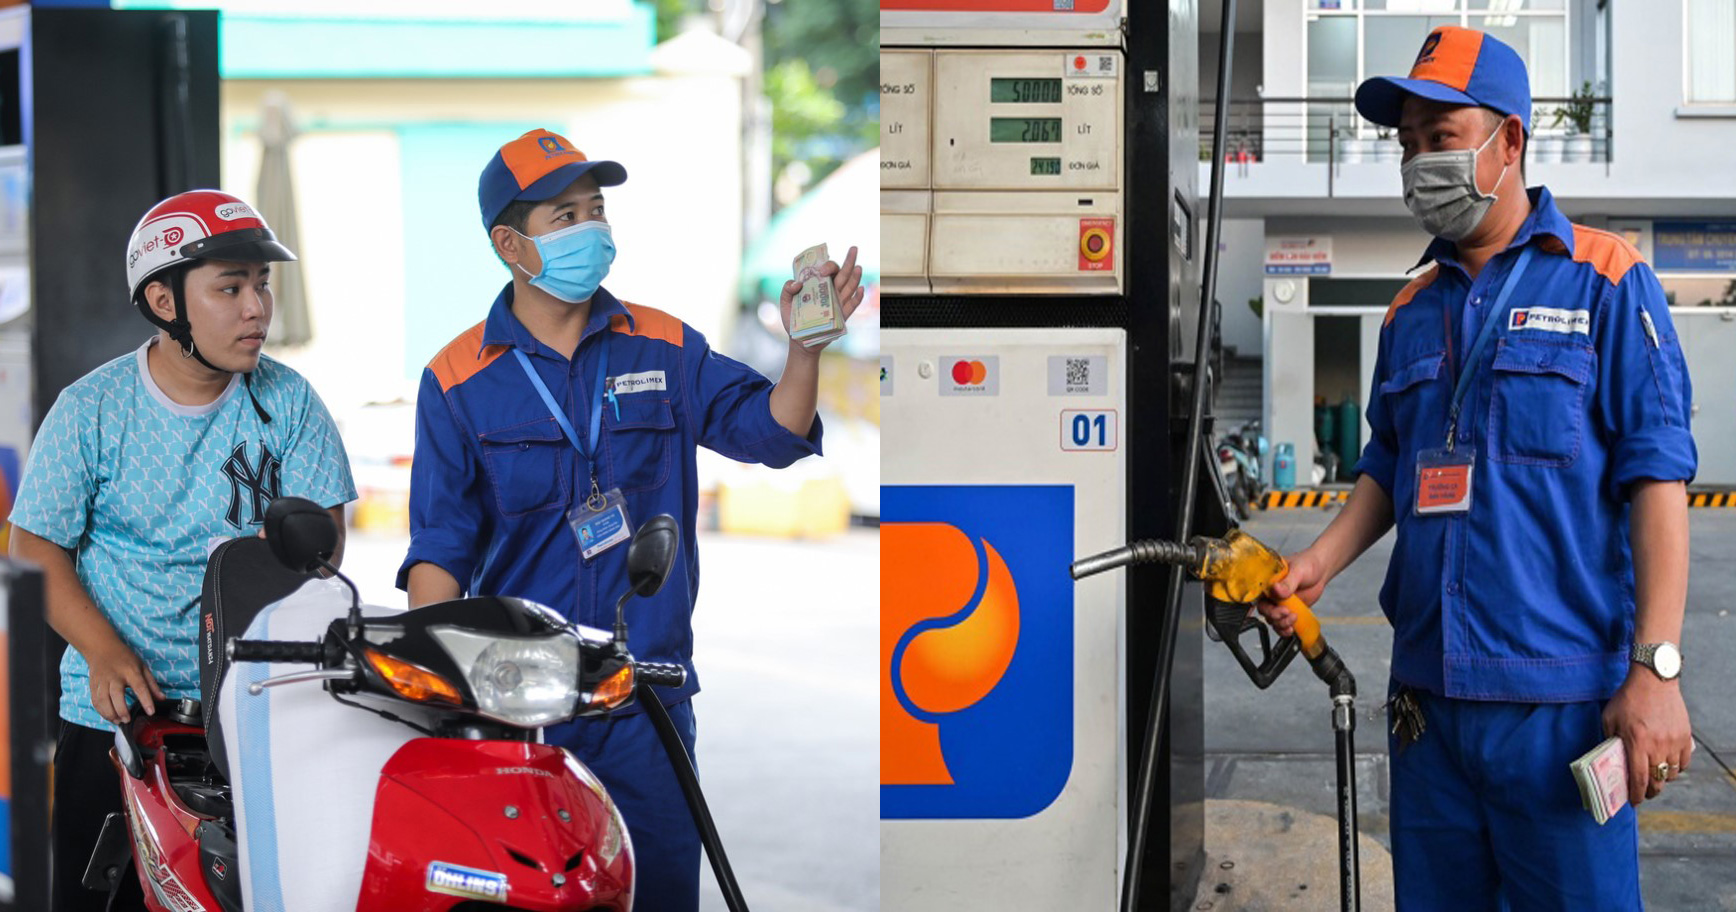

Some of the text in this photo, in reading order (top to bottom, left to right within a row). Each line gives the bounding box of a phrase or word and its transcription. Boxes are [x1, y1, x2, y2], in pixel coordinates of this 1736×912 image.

[1013, 81, 1060, 102] 50000
[1072, 414, 1106, 446] 01
[496, 767, 554, 778] HONDA
